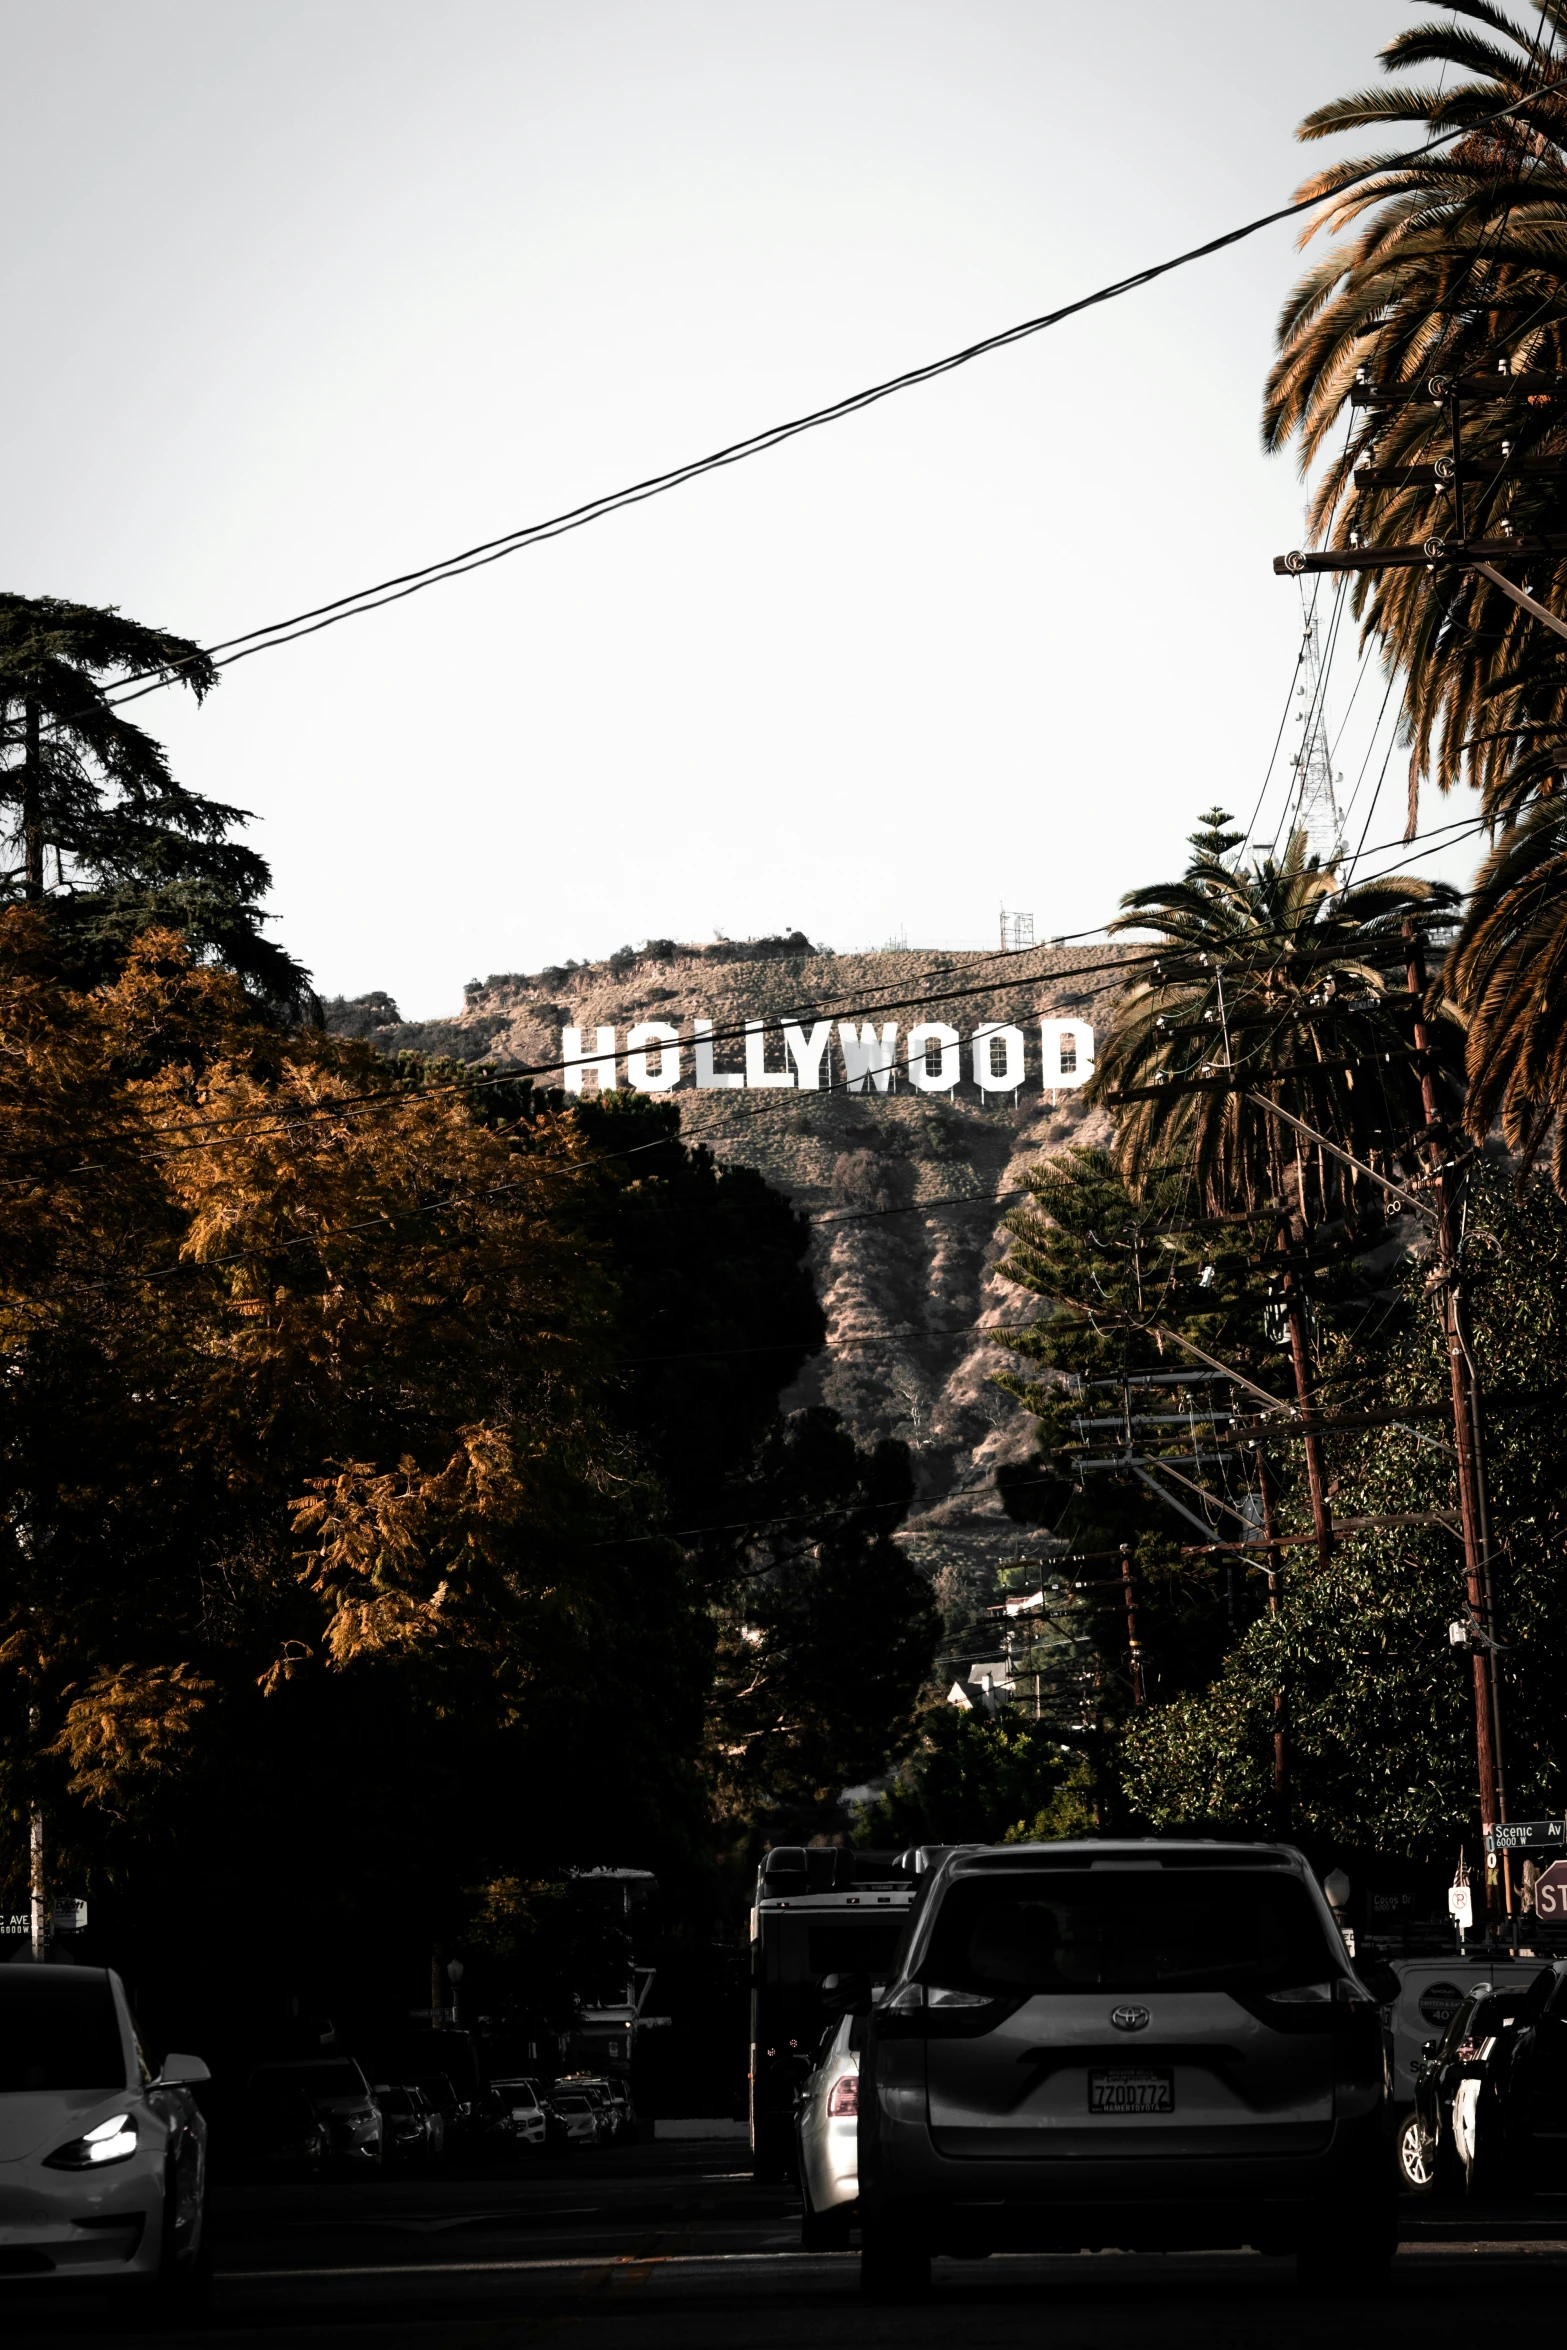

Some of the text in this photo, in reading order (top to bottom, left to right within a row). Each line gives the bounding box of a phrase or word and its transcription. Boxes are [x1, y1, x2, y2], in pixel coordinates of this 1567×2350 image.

[562, 1018, 1094, 1092] HOLLYWOOD
[1495, 1823, 1562, 1838] Scenic Av
[1496, 1836, 1527, 1847] 6000 W
[1374, 1894, 1412, 1905] Cocos Dr
[9, 1915, 31, 1925] AVE
